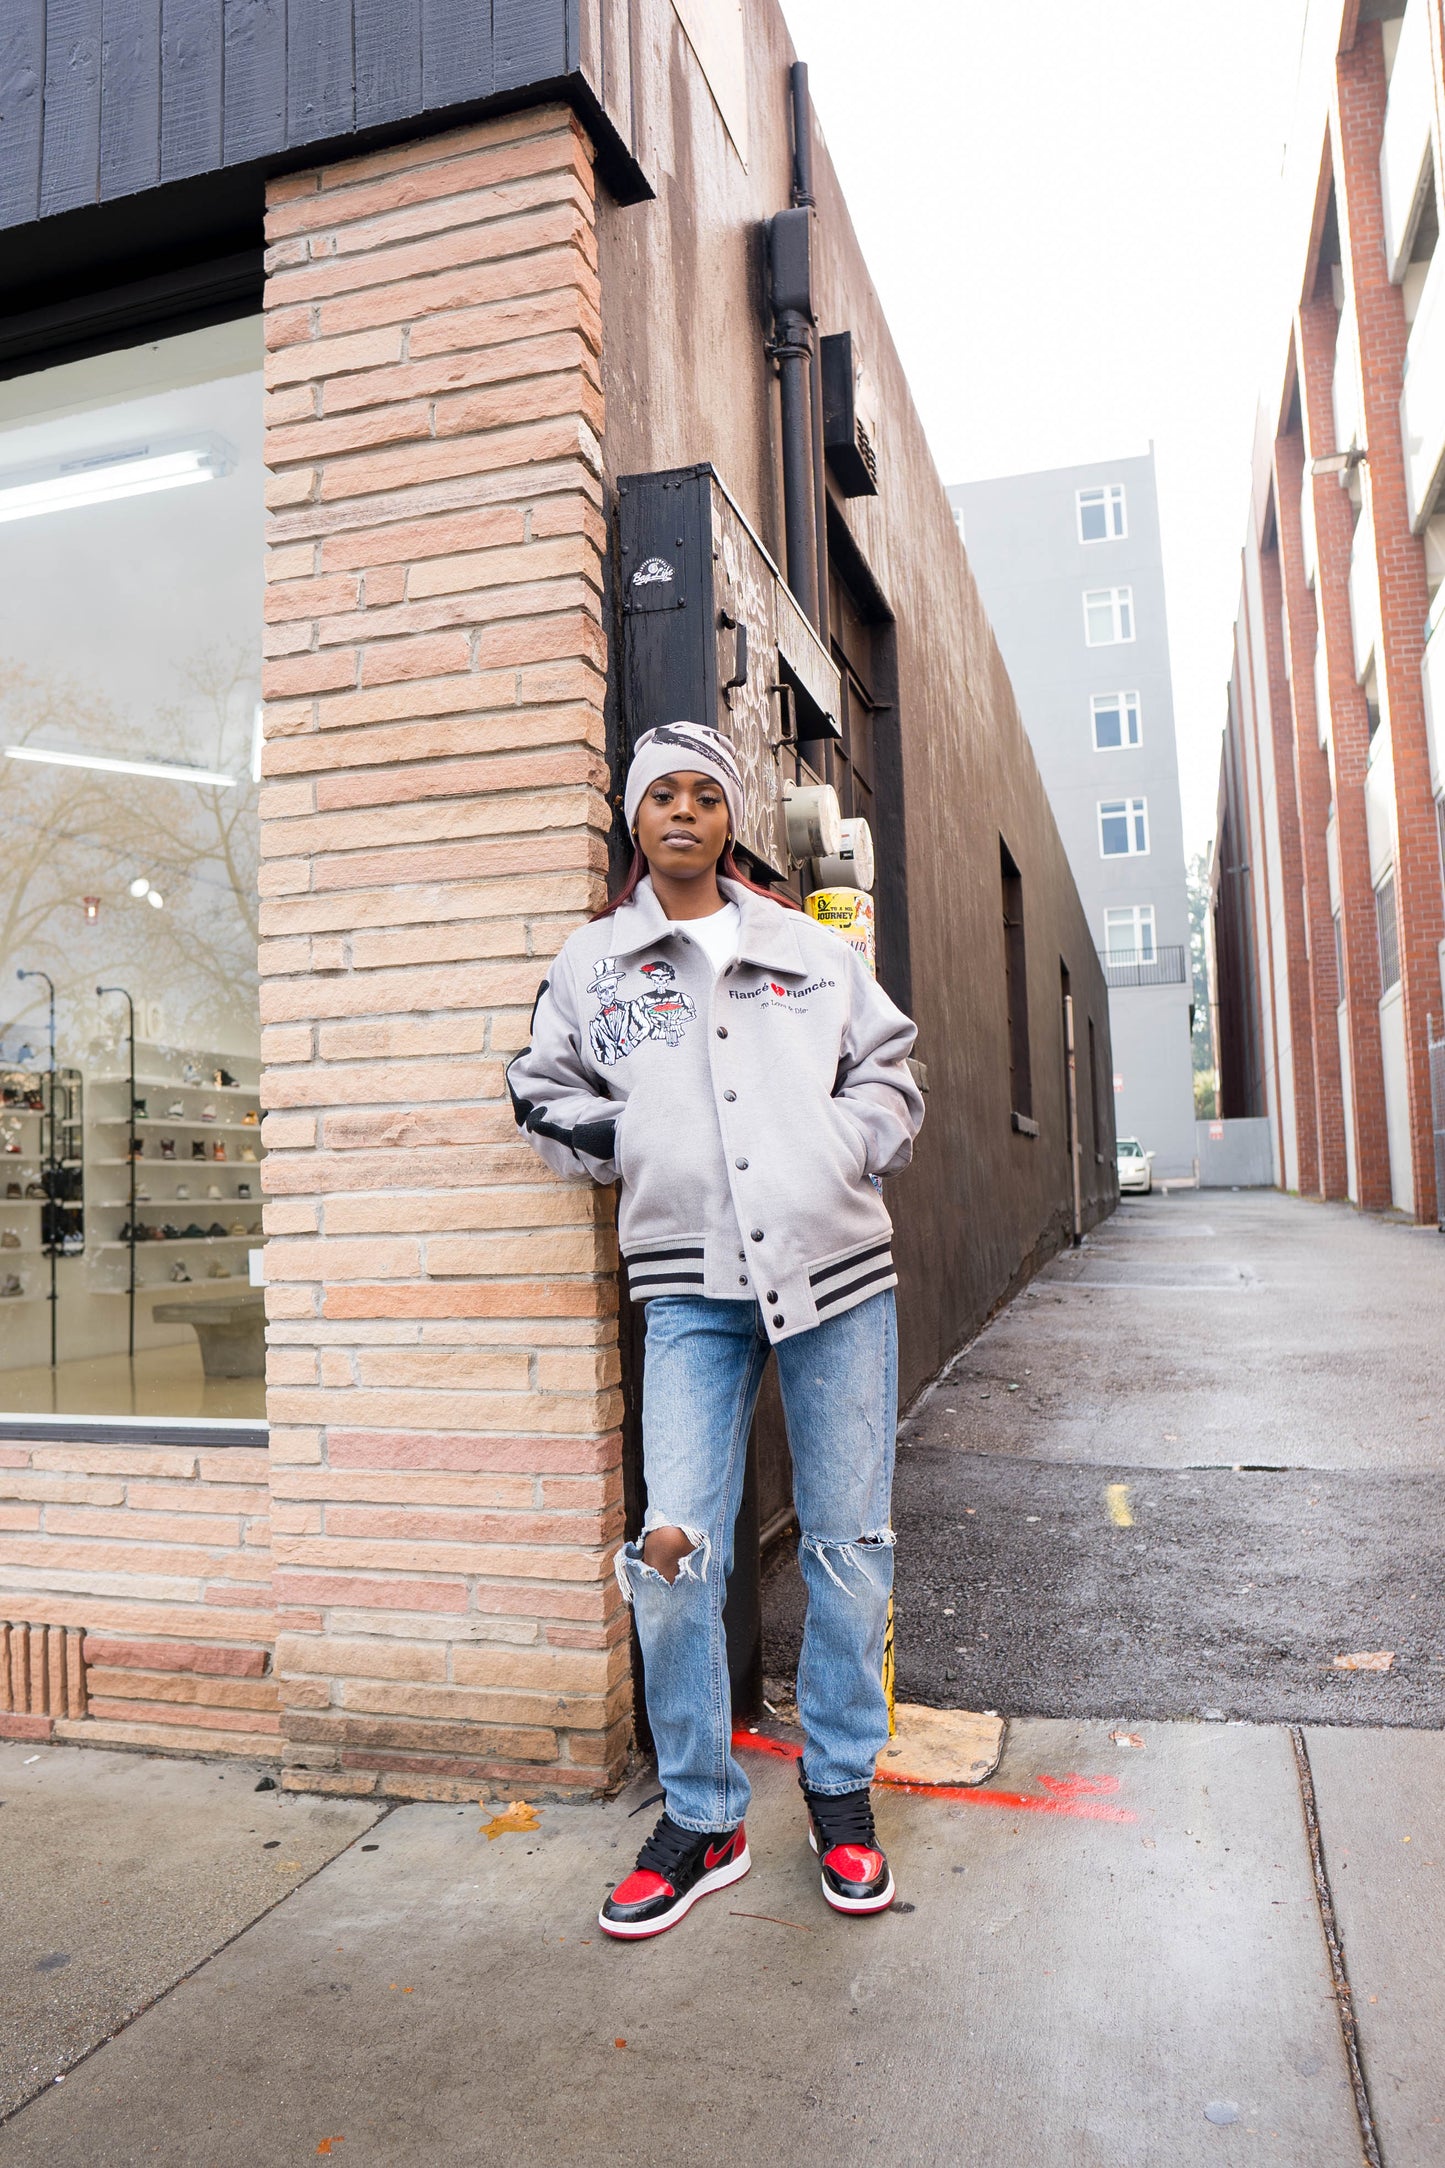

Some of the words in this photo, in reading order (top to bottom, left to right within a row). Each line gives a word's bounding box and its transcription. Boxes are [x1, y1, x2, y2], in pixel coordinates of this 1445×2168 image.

[817, 911, 854, 921] JOURNEY
[728, 982, 769, 1000] Fiancé
[786, 978, 836, 998] Fiancée
